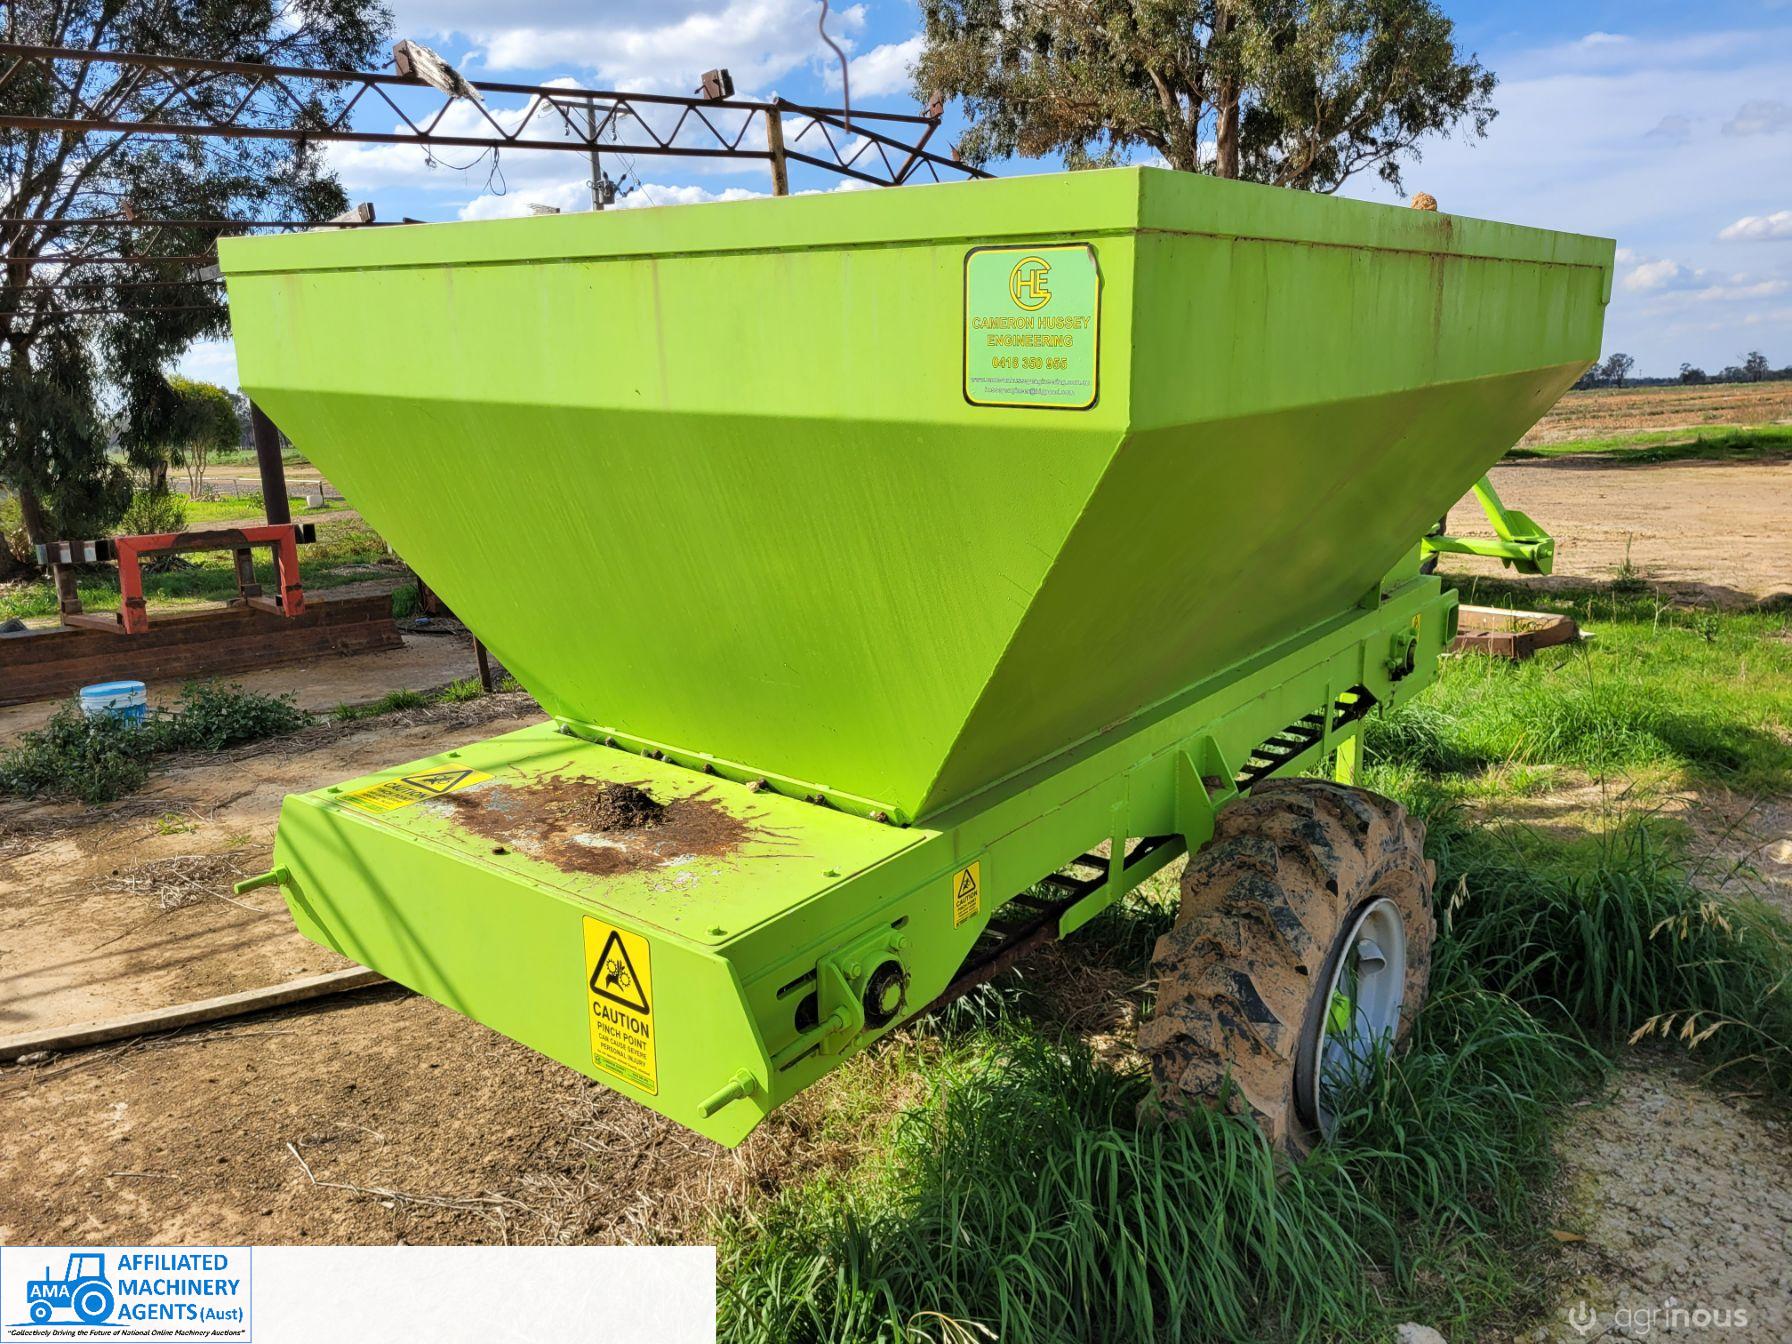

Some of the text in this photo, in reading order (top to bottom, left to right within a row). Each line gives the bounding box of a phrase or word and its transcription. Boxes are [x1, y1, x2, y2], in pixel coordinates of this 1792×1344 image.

[972, 316, 1091, 329] CAMERON HUSSEY
[986, 335, 1073, 347] ENGINEERING
[383, 782, 427, 798] CAUTION
[956, 890, 978, 907] CAUTION
[593, 1001, 650, 1039] CAUTION
[597, 1021, 647, 1051] PINCH POINT
[598, 1033, 647, 1060] CAN CAUSE SEVERE
[600, 1042, 627, 1059] PERSONAL
[627, 1054, 647, 1067] INJURY
